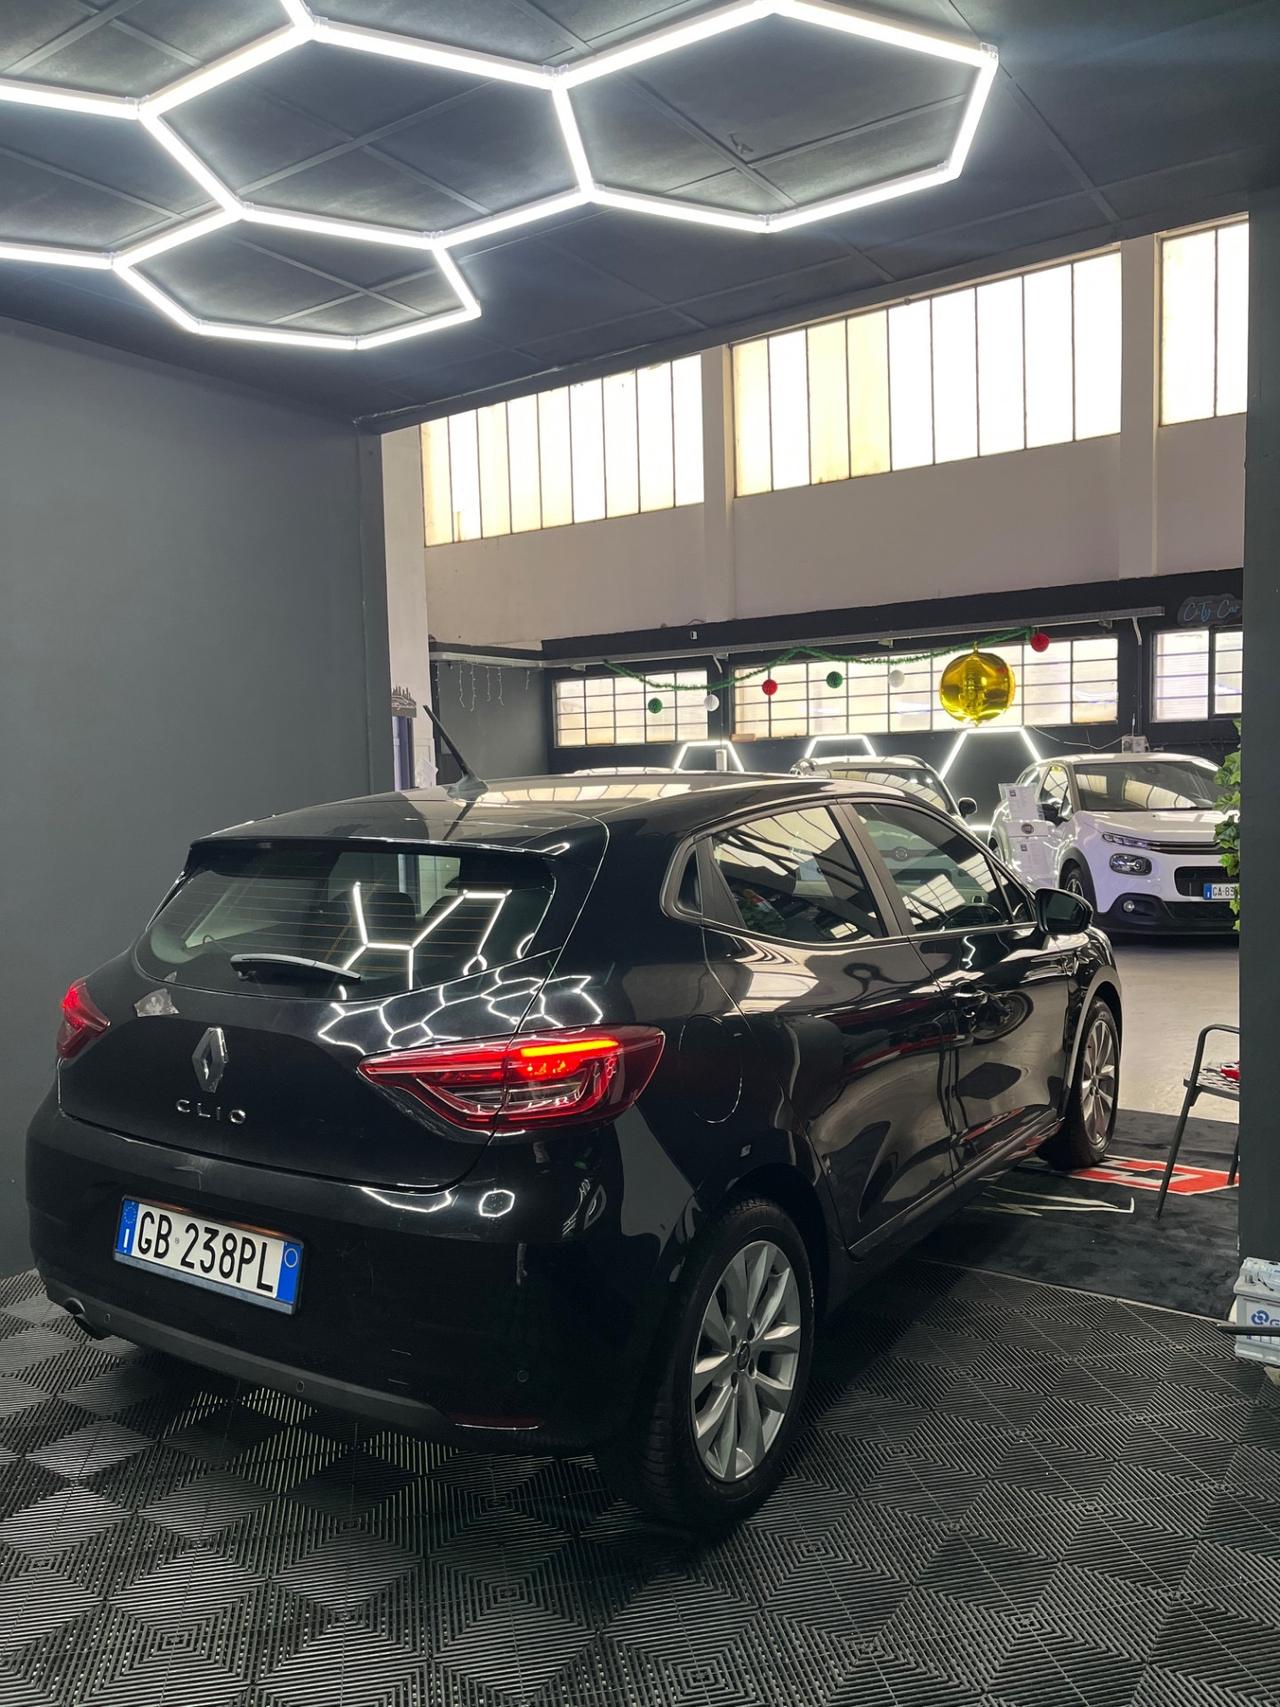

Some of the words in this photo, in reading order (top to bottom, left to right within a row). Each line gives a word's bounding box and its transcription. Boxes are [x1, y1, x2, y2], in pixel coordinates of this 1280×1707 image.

[176, 1099, 246, 1124] CLIO
[137, 1210, 173, 1259] GB
[180, 1222, 274, 1293] 238PL
